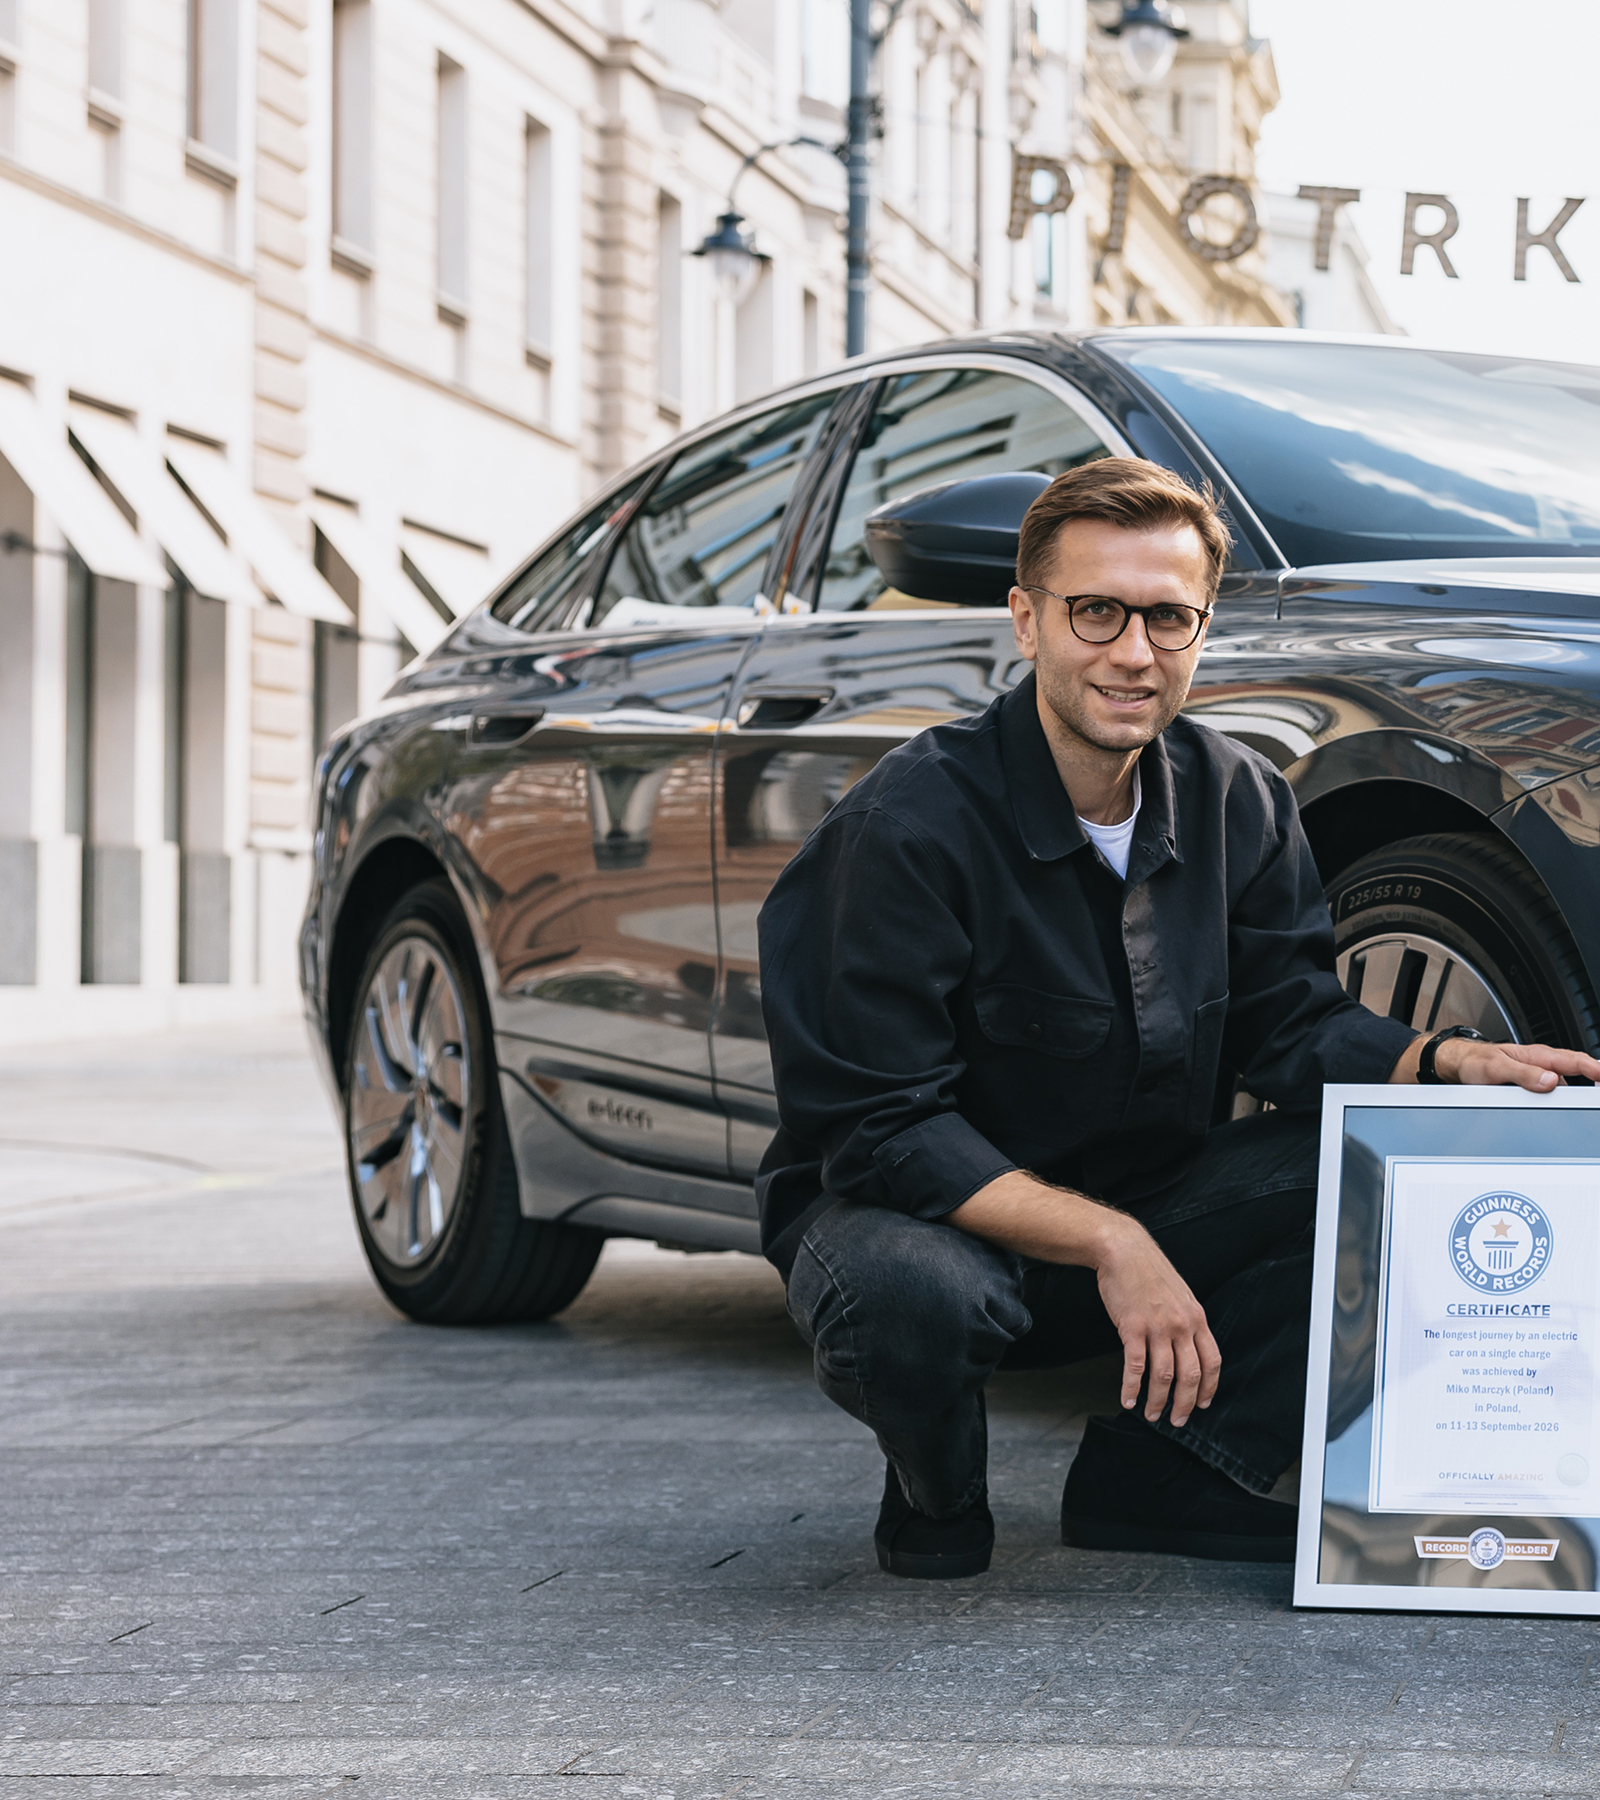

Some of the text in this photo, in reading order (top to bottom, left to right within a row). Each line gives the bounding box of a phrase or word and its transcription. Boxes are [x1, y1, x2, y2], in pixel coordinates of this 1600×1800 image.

[1348, 883, 1422, 910] 225/55 R 19
[1464, 1196, 1541, 1226] GUINNESS
[1454, 1235, 1548, 1291] WORLD RECORDS
[1445, 1302, 1551, 1317] CERTIFICATE
[1424, 1329, 1578, 1342] The longest journey by an electric
[1449, 1348, 1551, 1361] car on a single charge
[1461, 1366, 1537, 1379] was achieved by
[1446, 1383, 1554, 1397] Miko Marczyk (Poland)
[1474, 1402, 1521, 1414] in Poland,
[1435, 1420, 1560, 1432] on 11-13 September 2026
[1438, 1471, 1544, 1482] OFFICIALLY AMAZING
[1425, 1542, 1548, 1555] RECORD HOLDER
